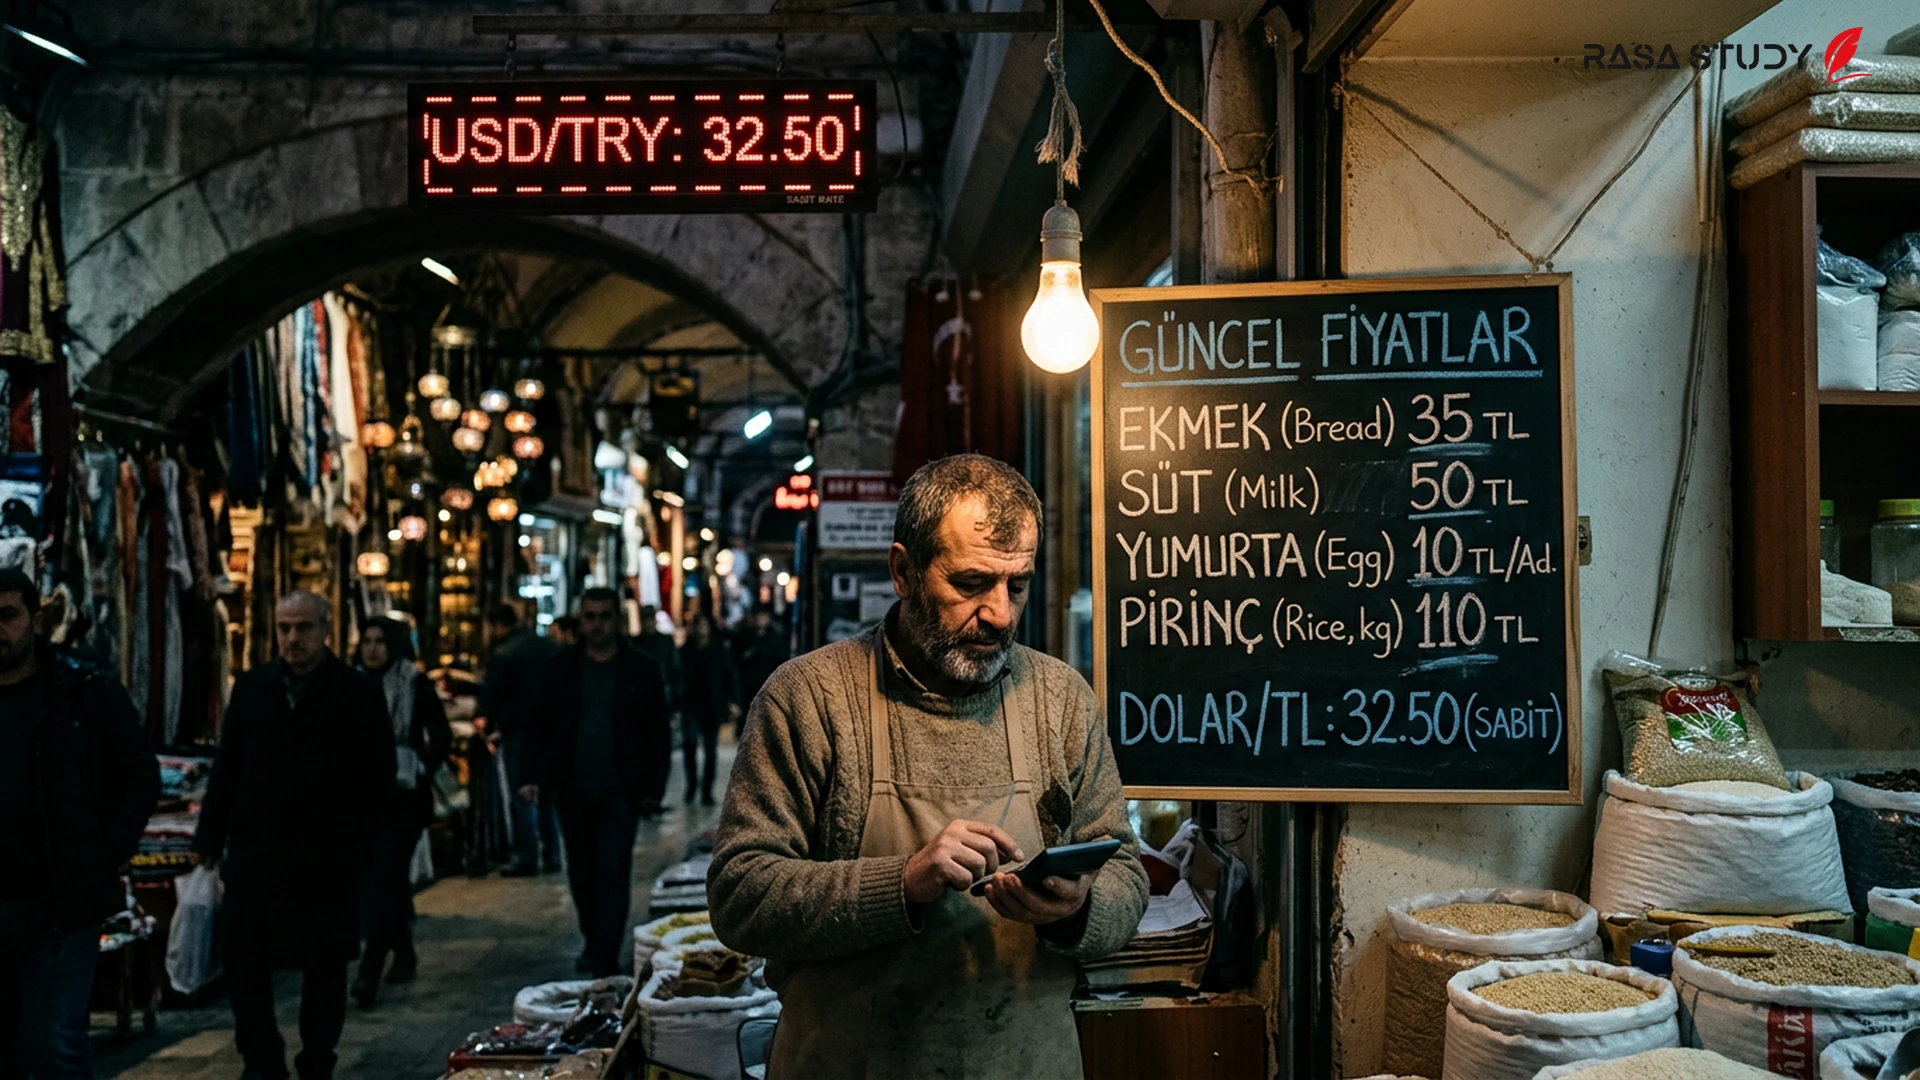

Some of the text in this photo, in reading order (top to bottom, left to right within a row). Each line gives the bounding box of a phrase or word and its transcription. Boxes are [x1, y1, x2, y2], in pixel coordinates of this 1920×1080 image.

[431, 115, 844, 163] USD/TRY: 32.50
[1119, 304, 1538, 376] GÜNCEL FİYATLAR
[1118, 392, 1530, 452] EKMEK (Bread) 35 TL
[1117, 460, 1529, 518] SÜT (Milk) 50 TL
[1116, 525, 1558, 588] YUMURTA (Egg) 10 TL/Ad.
[1119, 588, 1263, 655] PİRİNÇ
[1415, 591, 1487, 649] 110
[1494, 615, 1539, 644] TL
